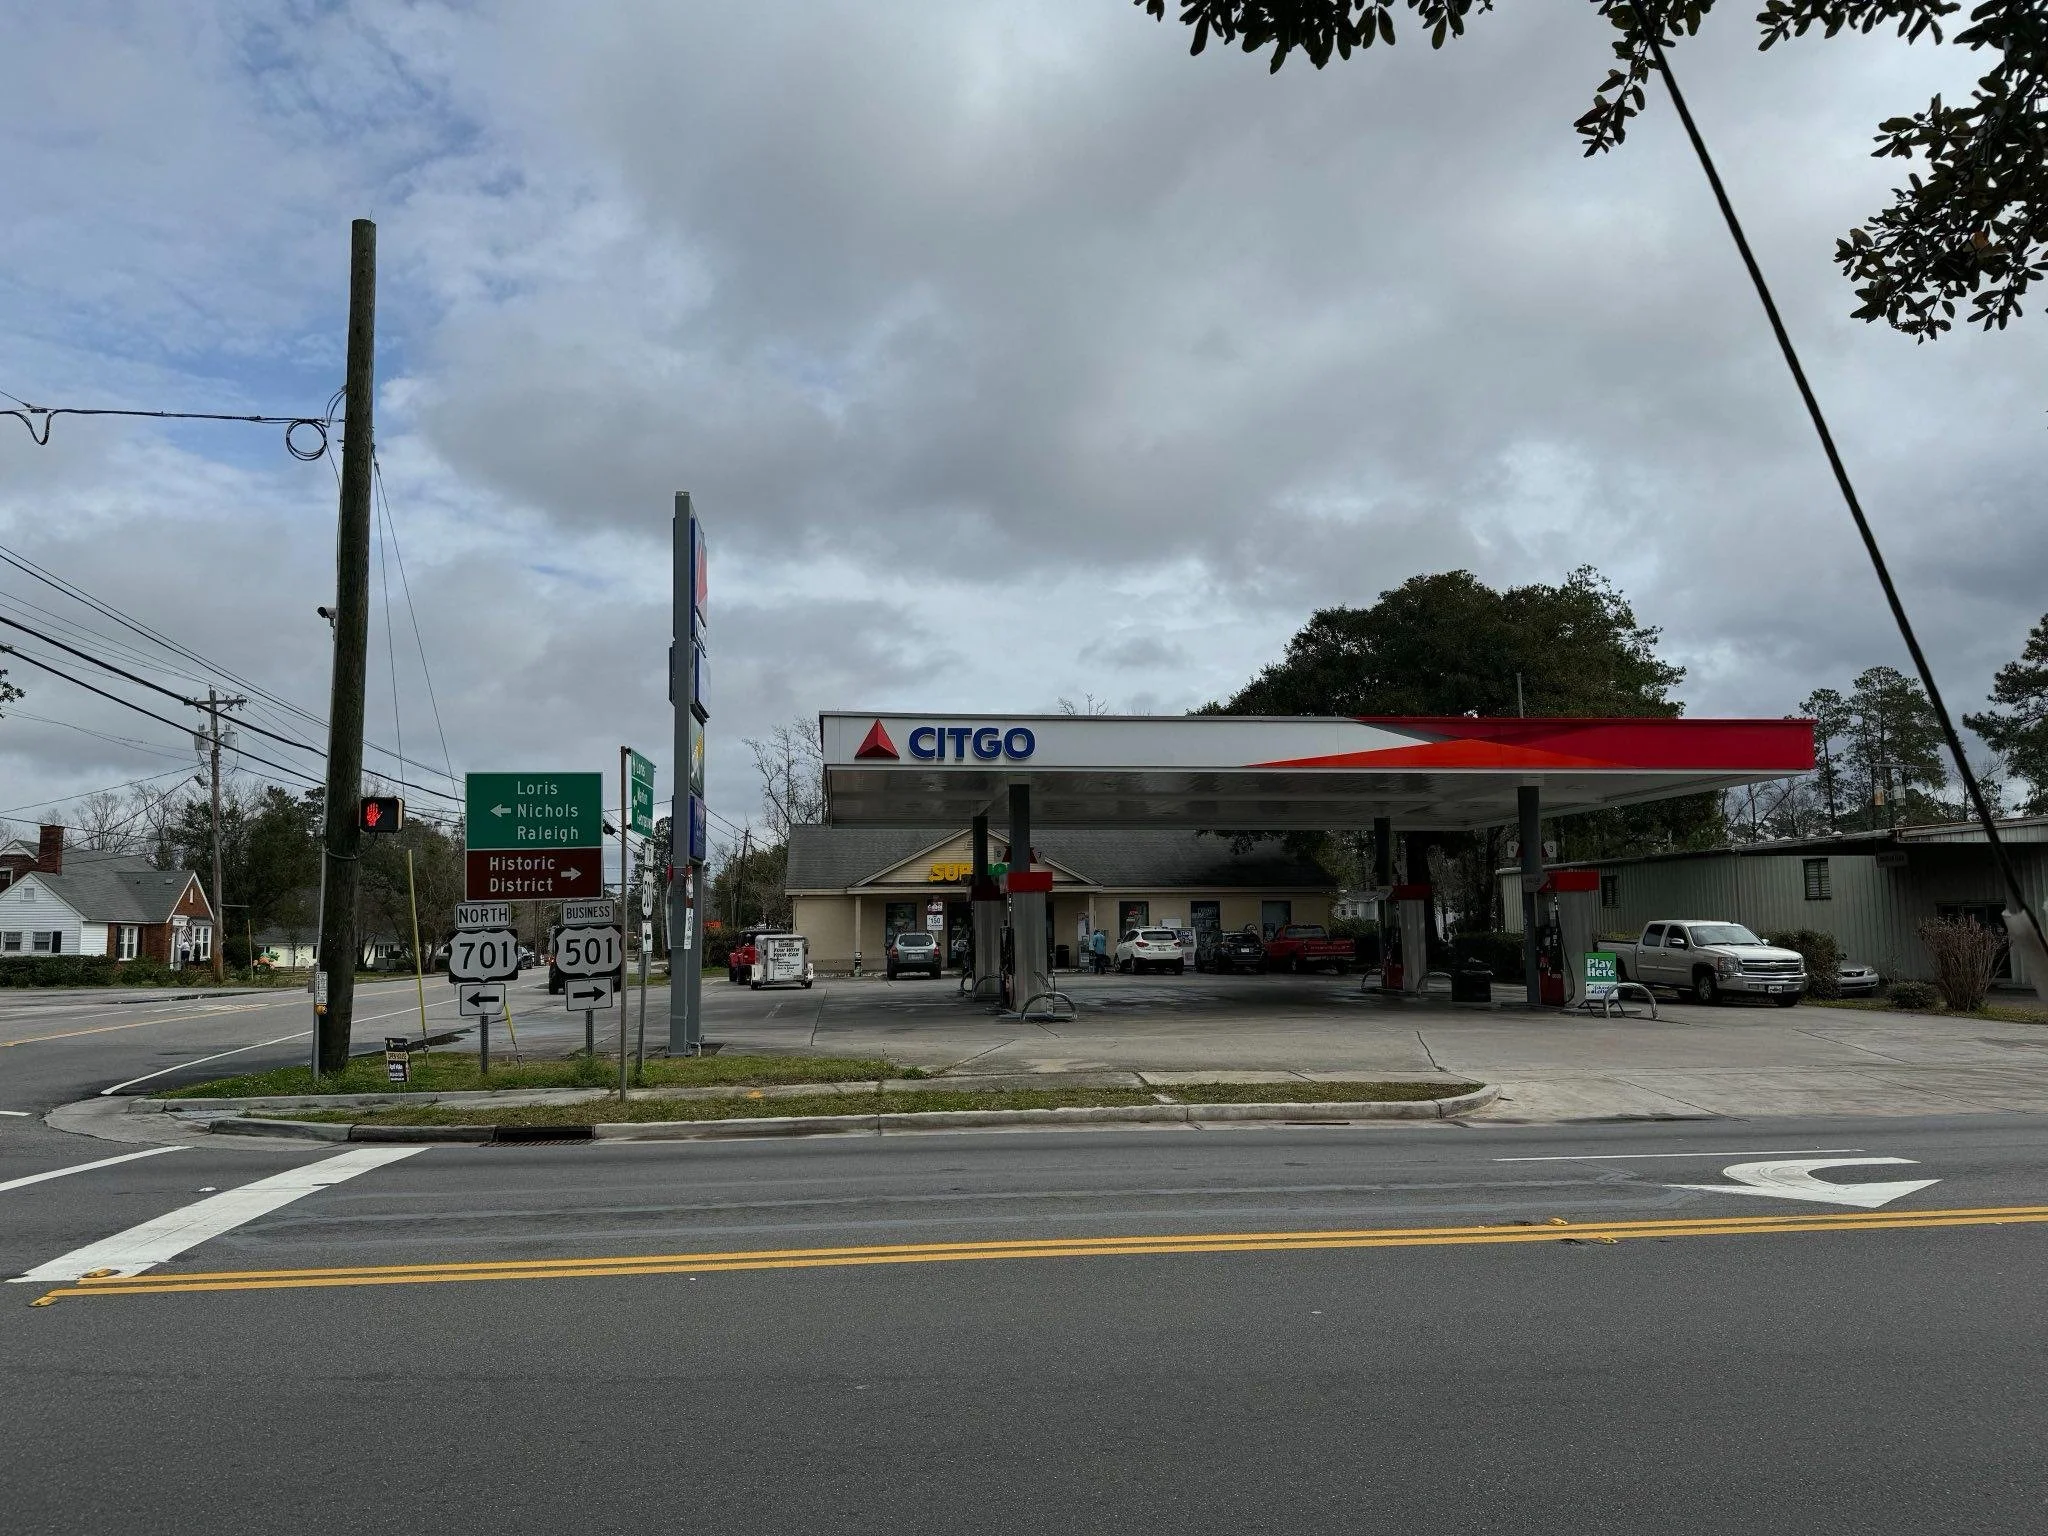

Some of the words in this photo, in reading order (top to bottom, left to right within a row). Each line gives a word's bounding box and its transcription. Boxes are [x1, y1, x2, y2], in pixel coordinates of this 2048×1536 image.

[909, 726, 1036, 760] CITGO
[517, 780, 558, 795] Loris
[517, 803, 579, 818] Nichols
[517, 825, 579, 843] Raleigh
[489, 856, 555, 871] Historic
[489, 877, 553, 893] District
[458, 907, 508, 924] NORTH
[566, 905, 610, 920] BUSINESS
[459, 940, 509, 970] 701
[565, 937, 612, 966] 501
[1587, 958, 1613, 971] Play
[1587, 967, 1615, 977] Here
